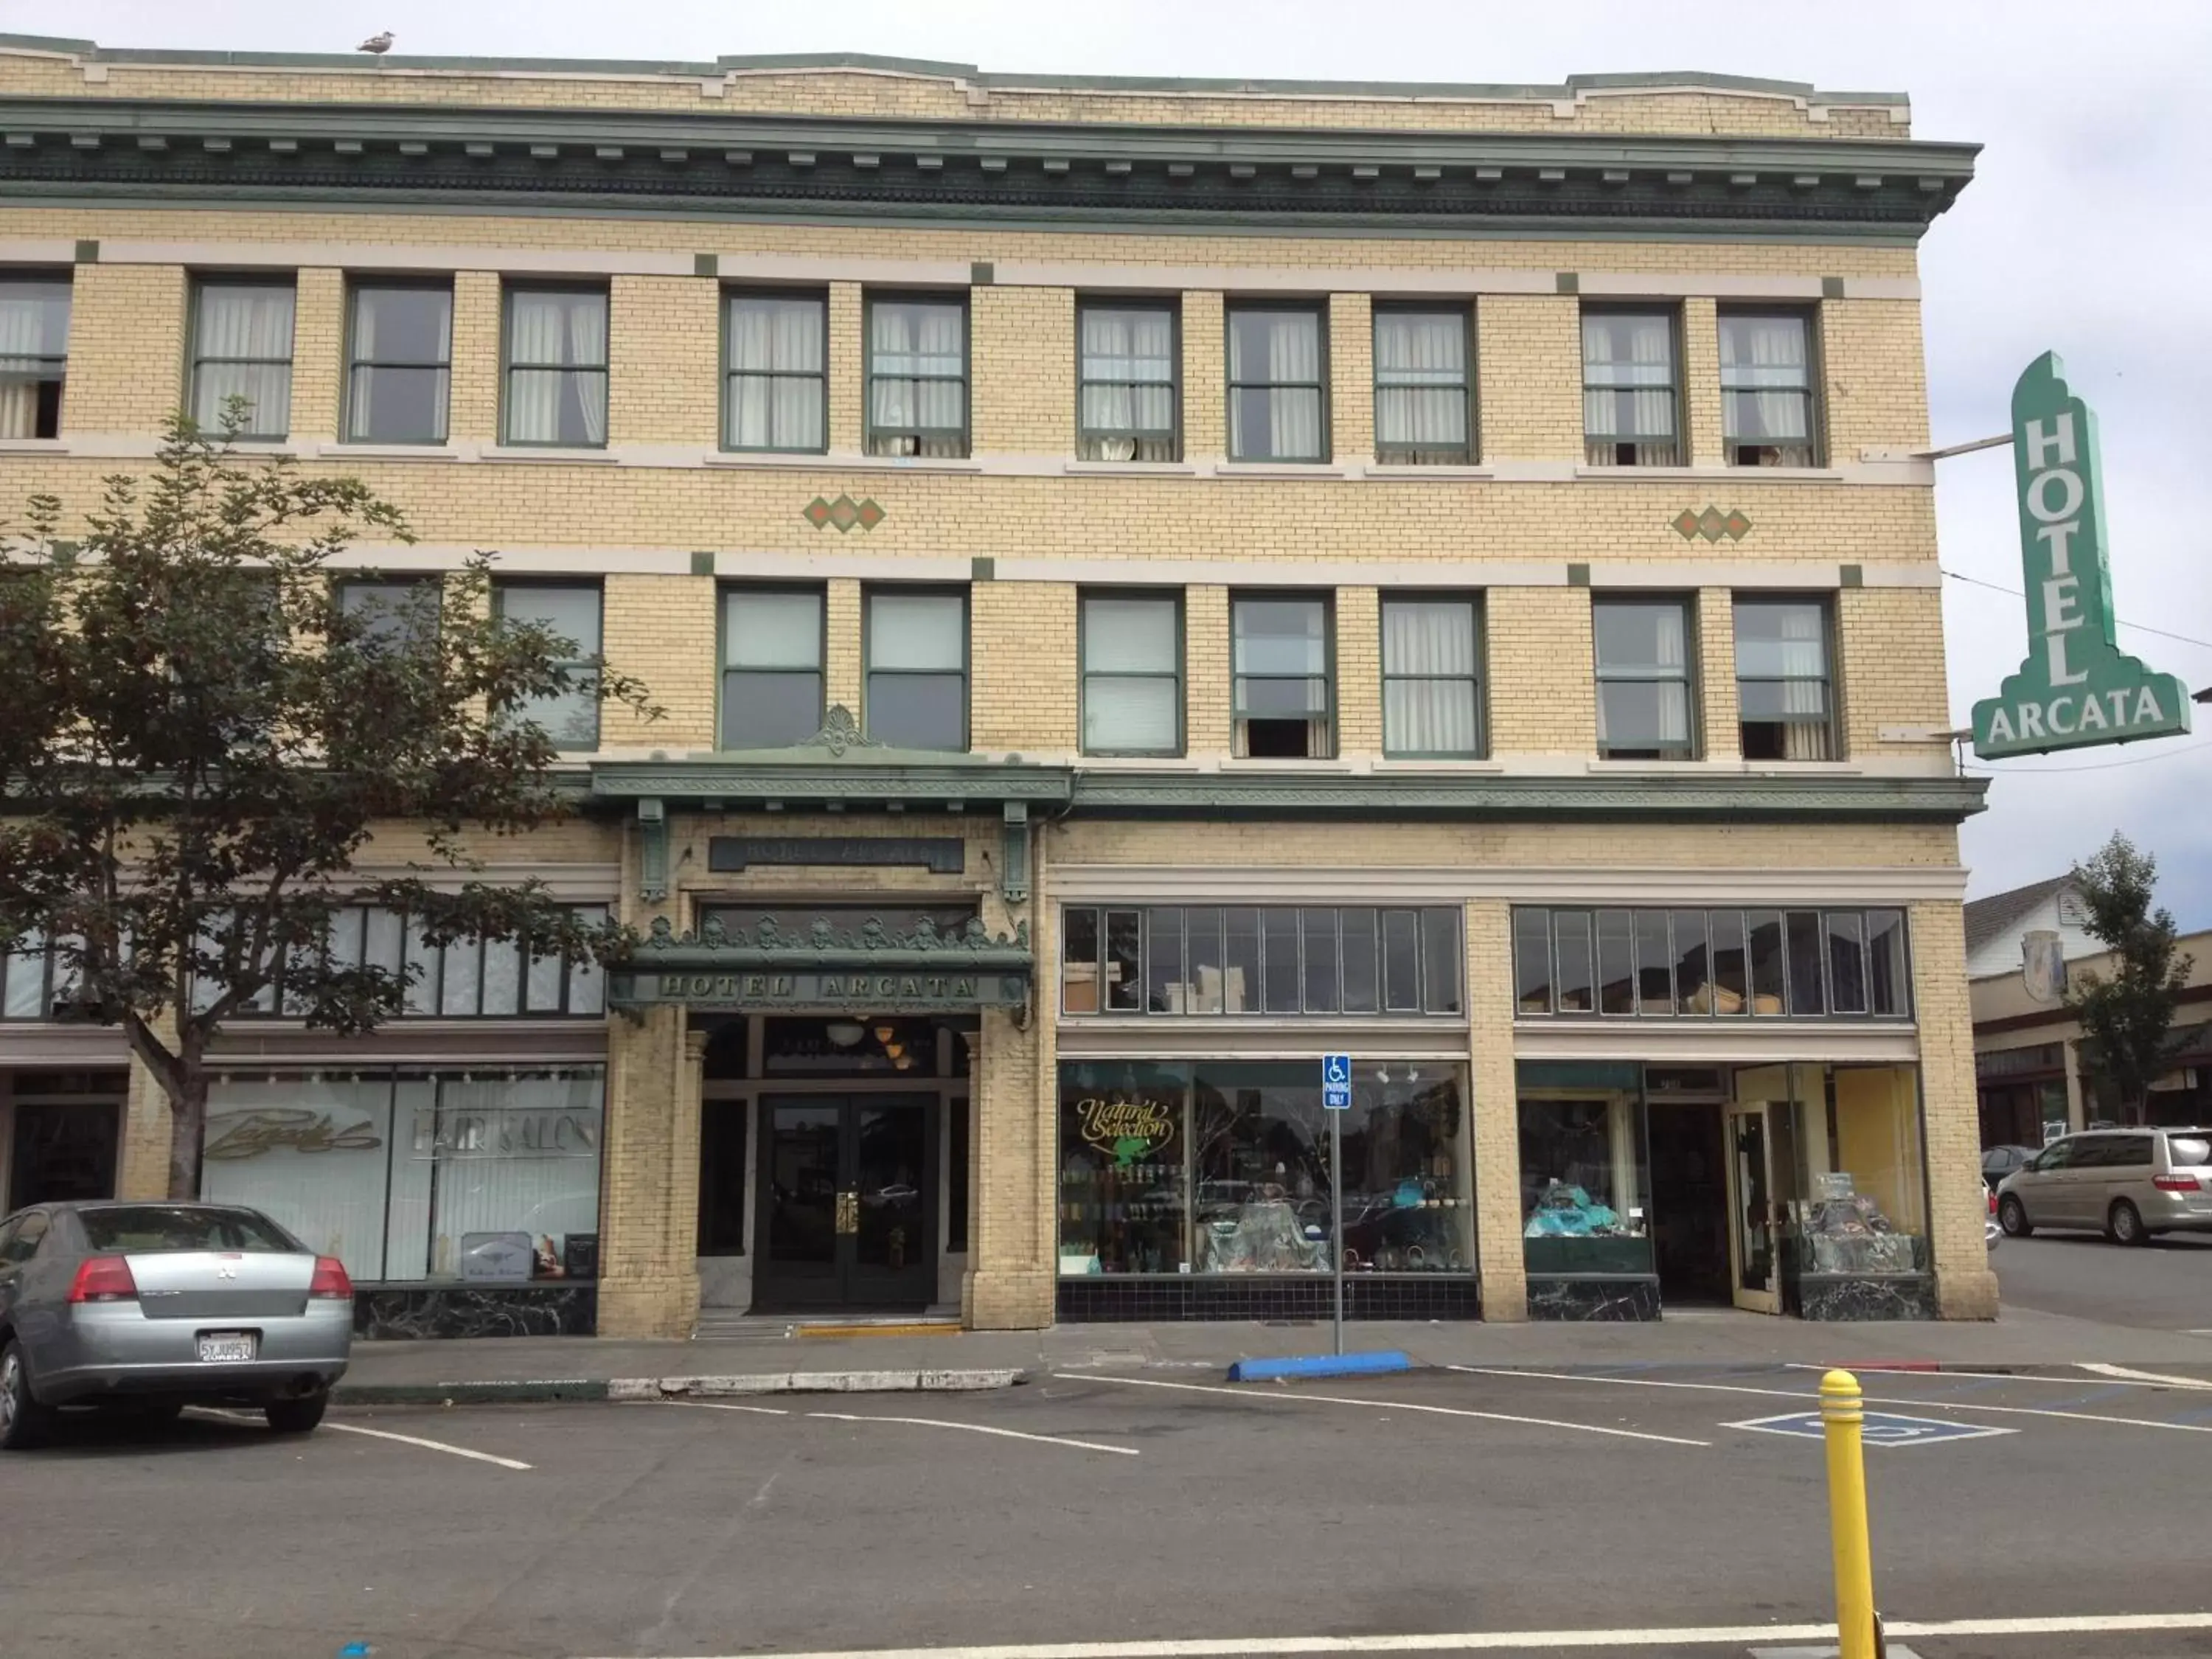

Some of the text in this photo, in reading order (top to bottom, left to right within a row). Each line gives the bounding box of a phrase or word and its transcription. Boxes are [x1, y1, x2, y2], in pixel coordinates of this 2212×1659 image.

[2025, 412, 2088, 686] HOTEL
[1988, 685, 2164, 743] ARCATA
[664, 975, 975, 997] HOTEL ARCATA
[1077, 1098, 1159, 1131] Natural
[1082, 1119, 1174, 1141] Selection
[498, 1115, 594, 1150] SALON
